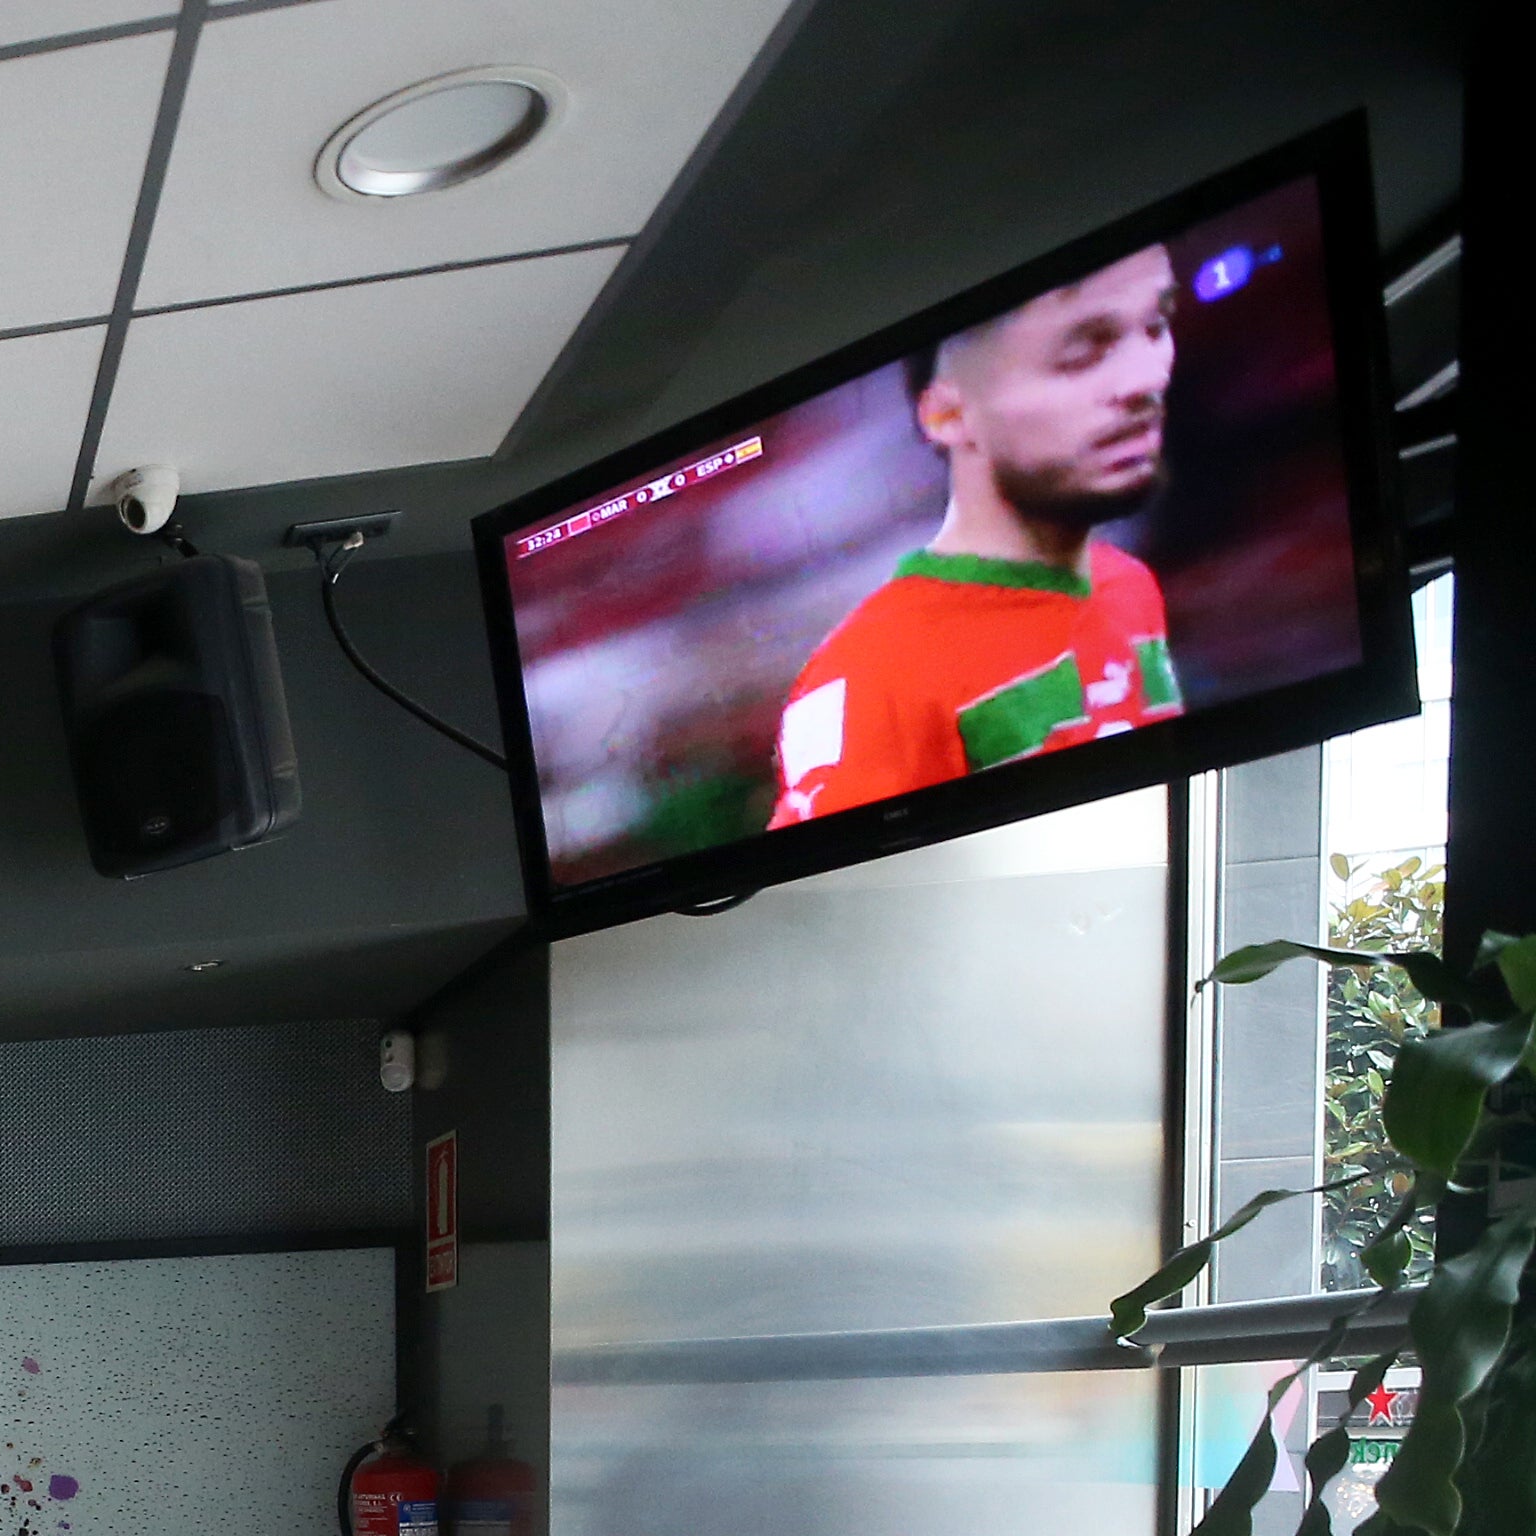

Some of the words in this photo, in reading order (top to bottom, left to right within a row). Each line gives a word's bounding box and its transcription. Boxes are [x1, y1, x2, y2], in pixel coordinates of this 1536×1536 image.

[600, 499, 627, 519] MAR
[636, 491, 647, 503] 0
[674, 474, 685, 486] 0
[697, 457, 722, 477] ESP
